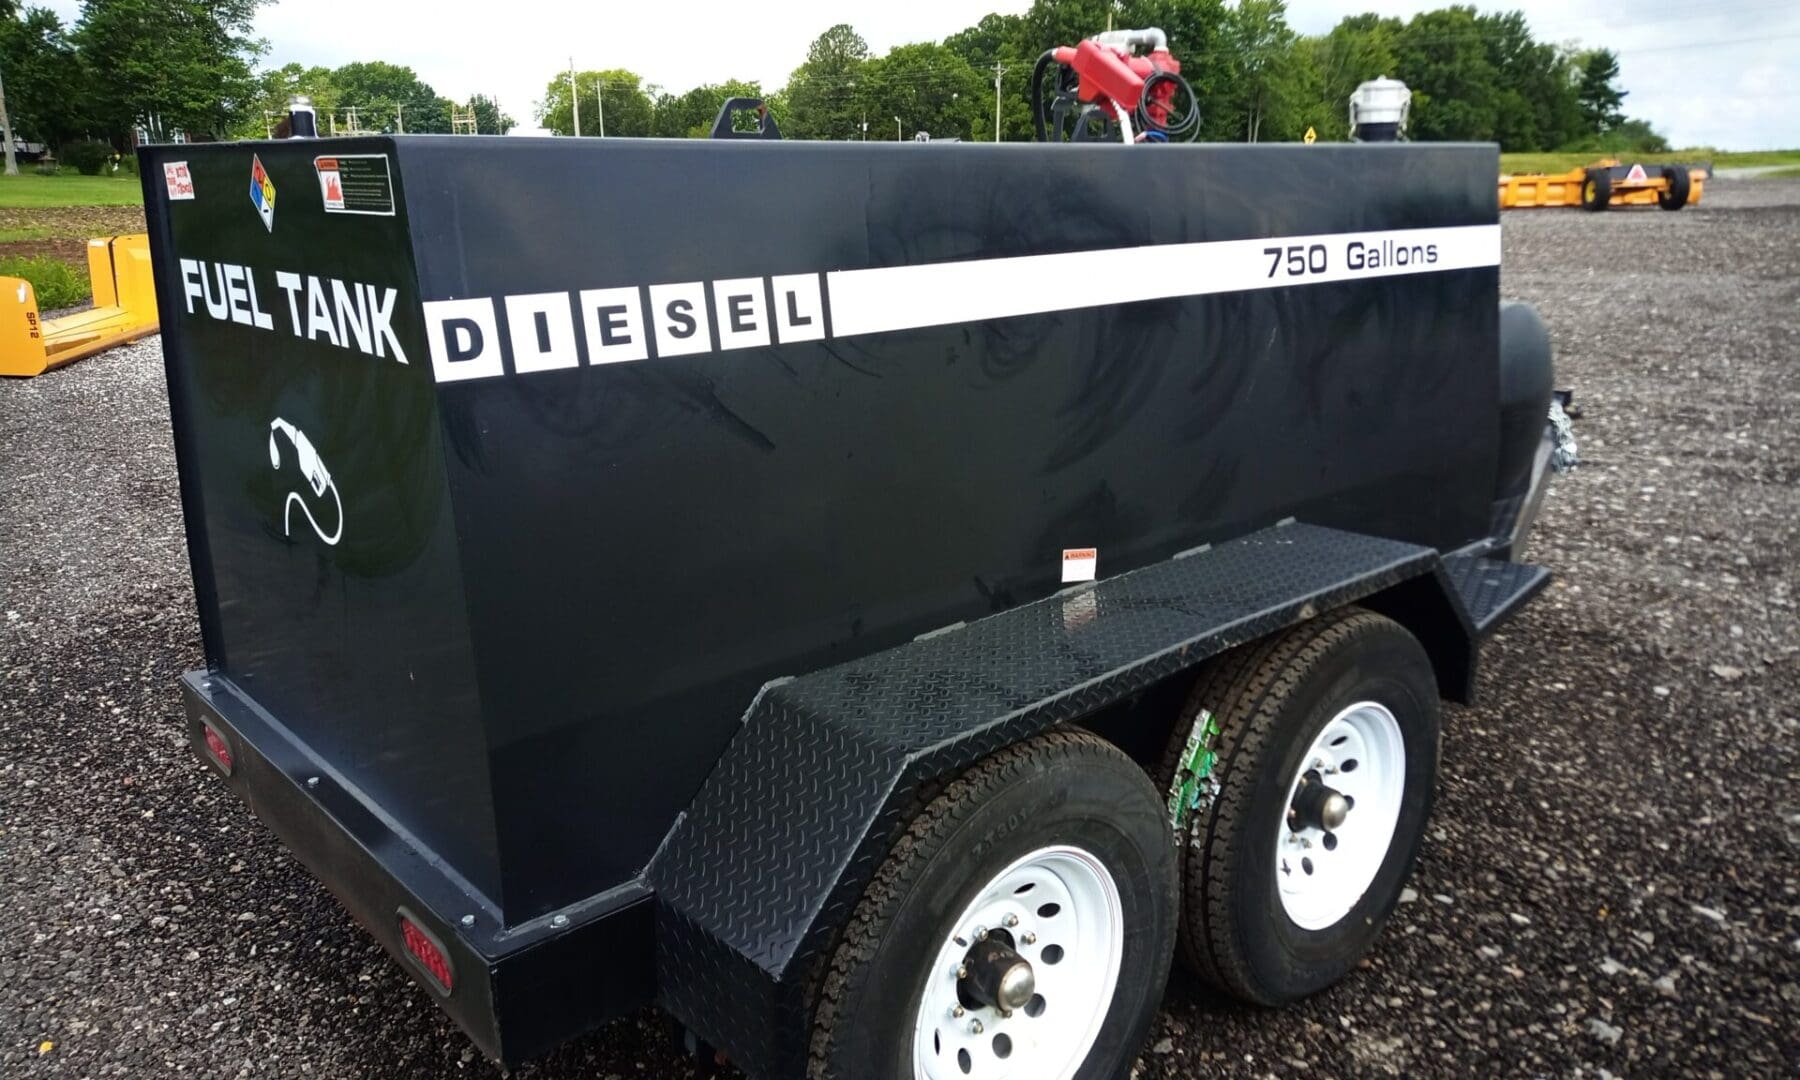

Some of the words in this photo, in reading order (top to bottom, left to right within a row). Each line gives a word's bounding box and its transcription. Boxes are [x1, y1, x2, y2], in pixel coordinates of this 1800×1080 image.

[1263, 244, 1327, 278] 750
[1347, 240, 1438, 270] Gallons
[26, 311, 39, 339] SP12
[180, 258, 274, 331] FUEL
[276, 270, 409, 365] TANK
[442, 290, 811, 363] DIESEL
